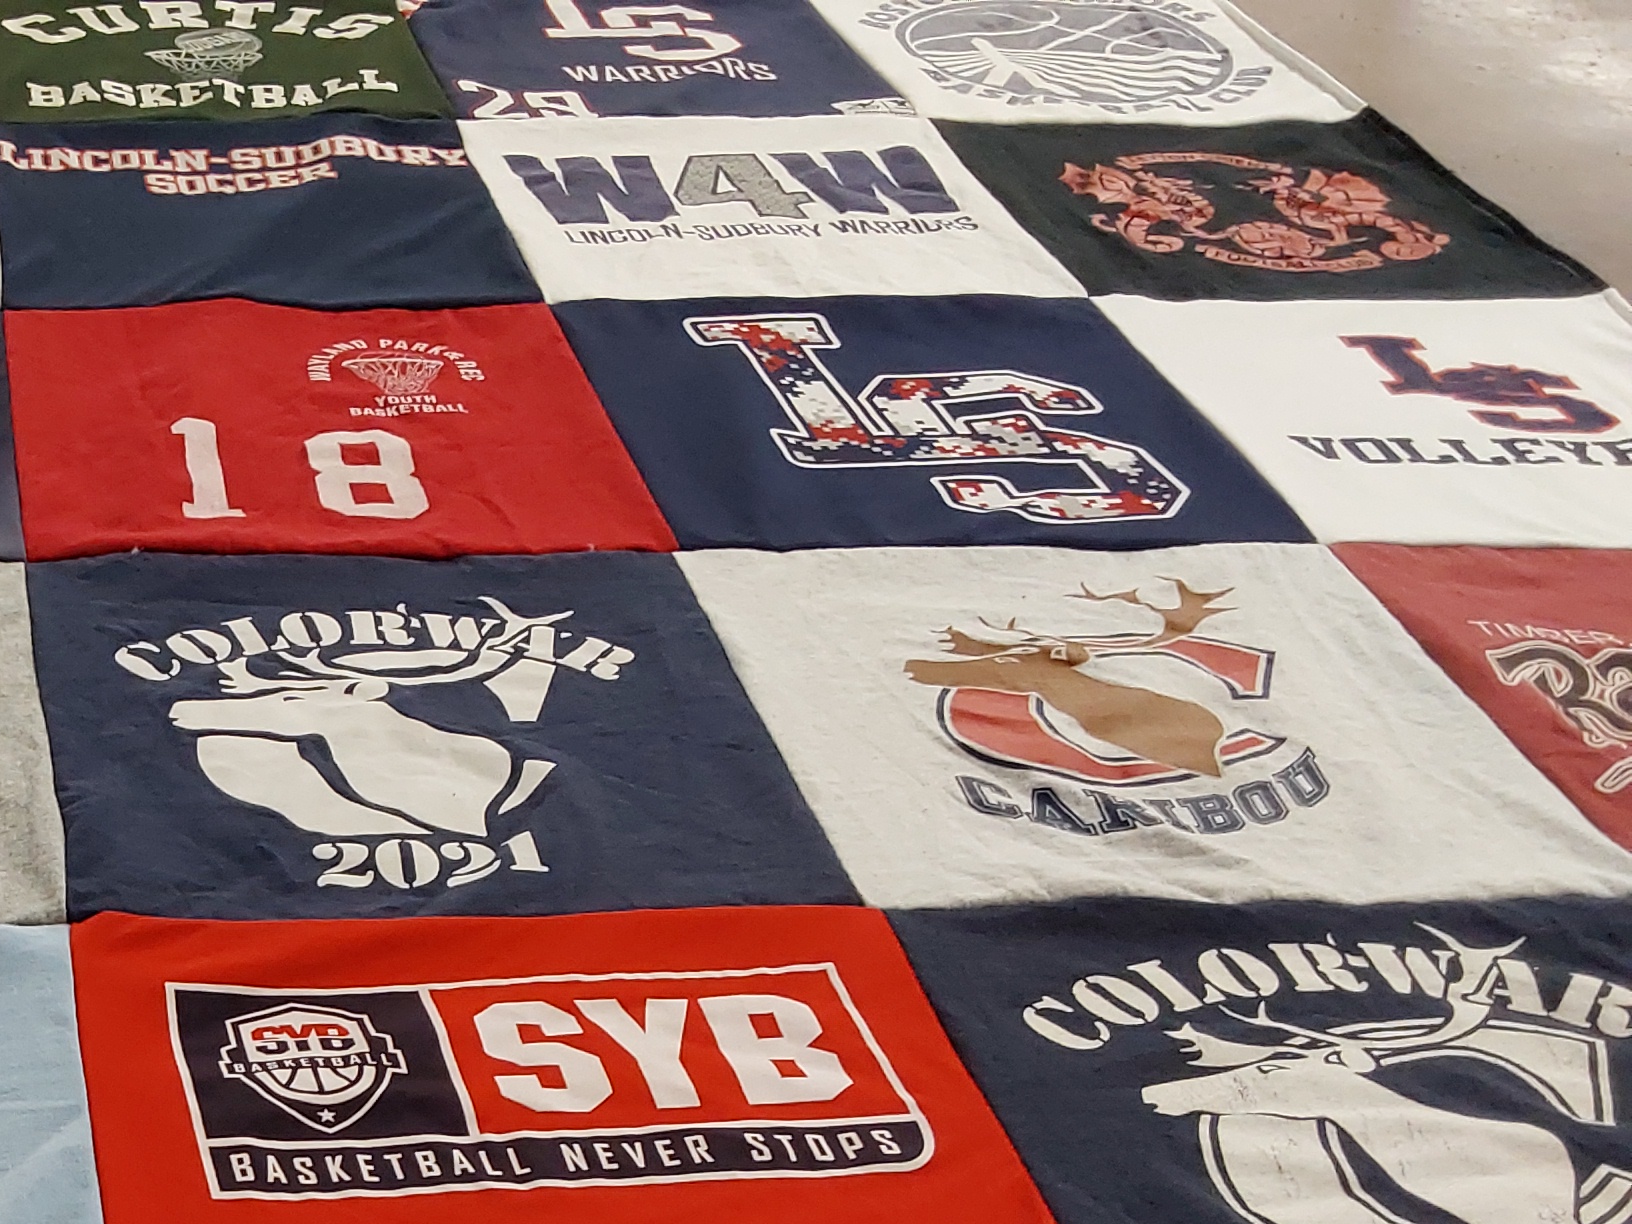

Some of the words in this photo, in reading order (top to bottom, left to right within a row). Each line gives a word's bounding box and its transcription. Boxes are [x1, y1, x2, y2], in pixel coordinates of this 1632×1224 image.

[1, 0, 395, 44] CURTIS
[25, 69, 399, 109] BASKETBALL
[561, 57, 778, 83] WARRIORS
[144, 162, 339, 194] SOCCER
[502, 144, 961, 226] W4W
[307, 338, 369, 382] WAYLAND
[379, 338, 449, 357] PARK
[349, 403, 469, 417] BASKETBALL
[374, 394, 437, 407] YOUTH
[683, 313, 1191, 524] LS
[954, 747, 1331, 836] CARIBOU
[251, 1023, 357, 1056] SYB
[472, 994, 855, 1114] SYB
[232, 1052, 394, 1074] BASKETBALL
[232, 1144, 532, 1188] BASKETBALL
[566, 1138, 716, 1173] NEVER
[748, 1128, 904, 1162] STOPS
